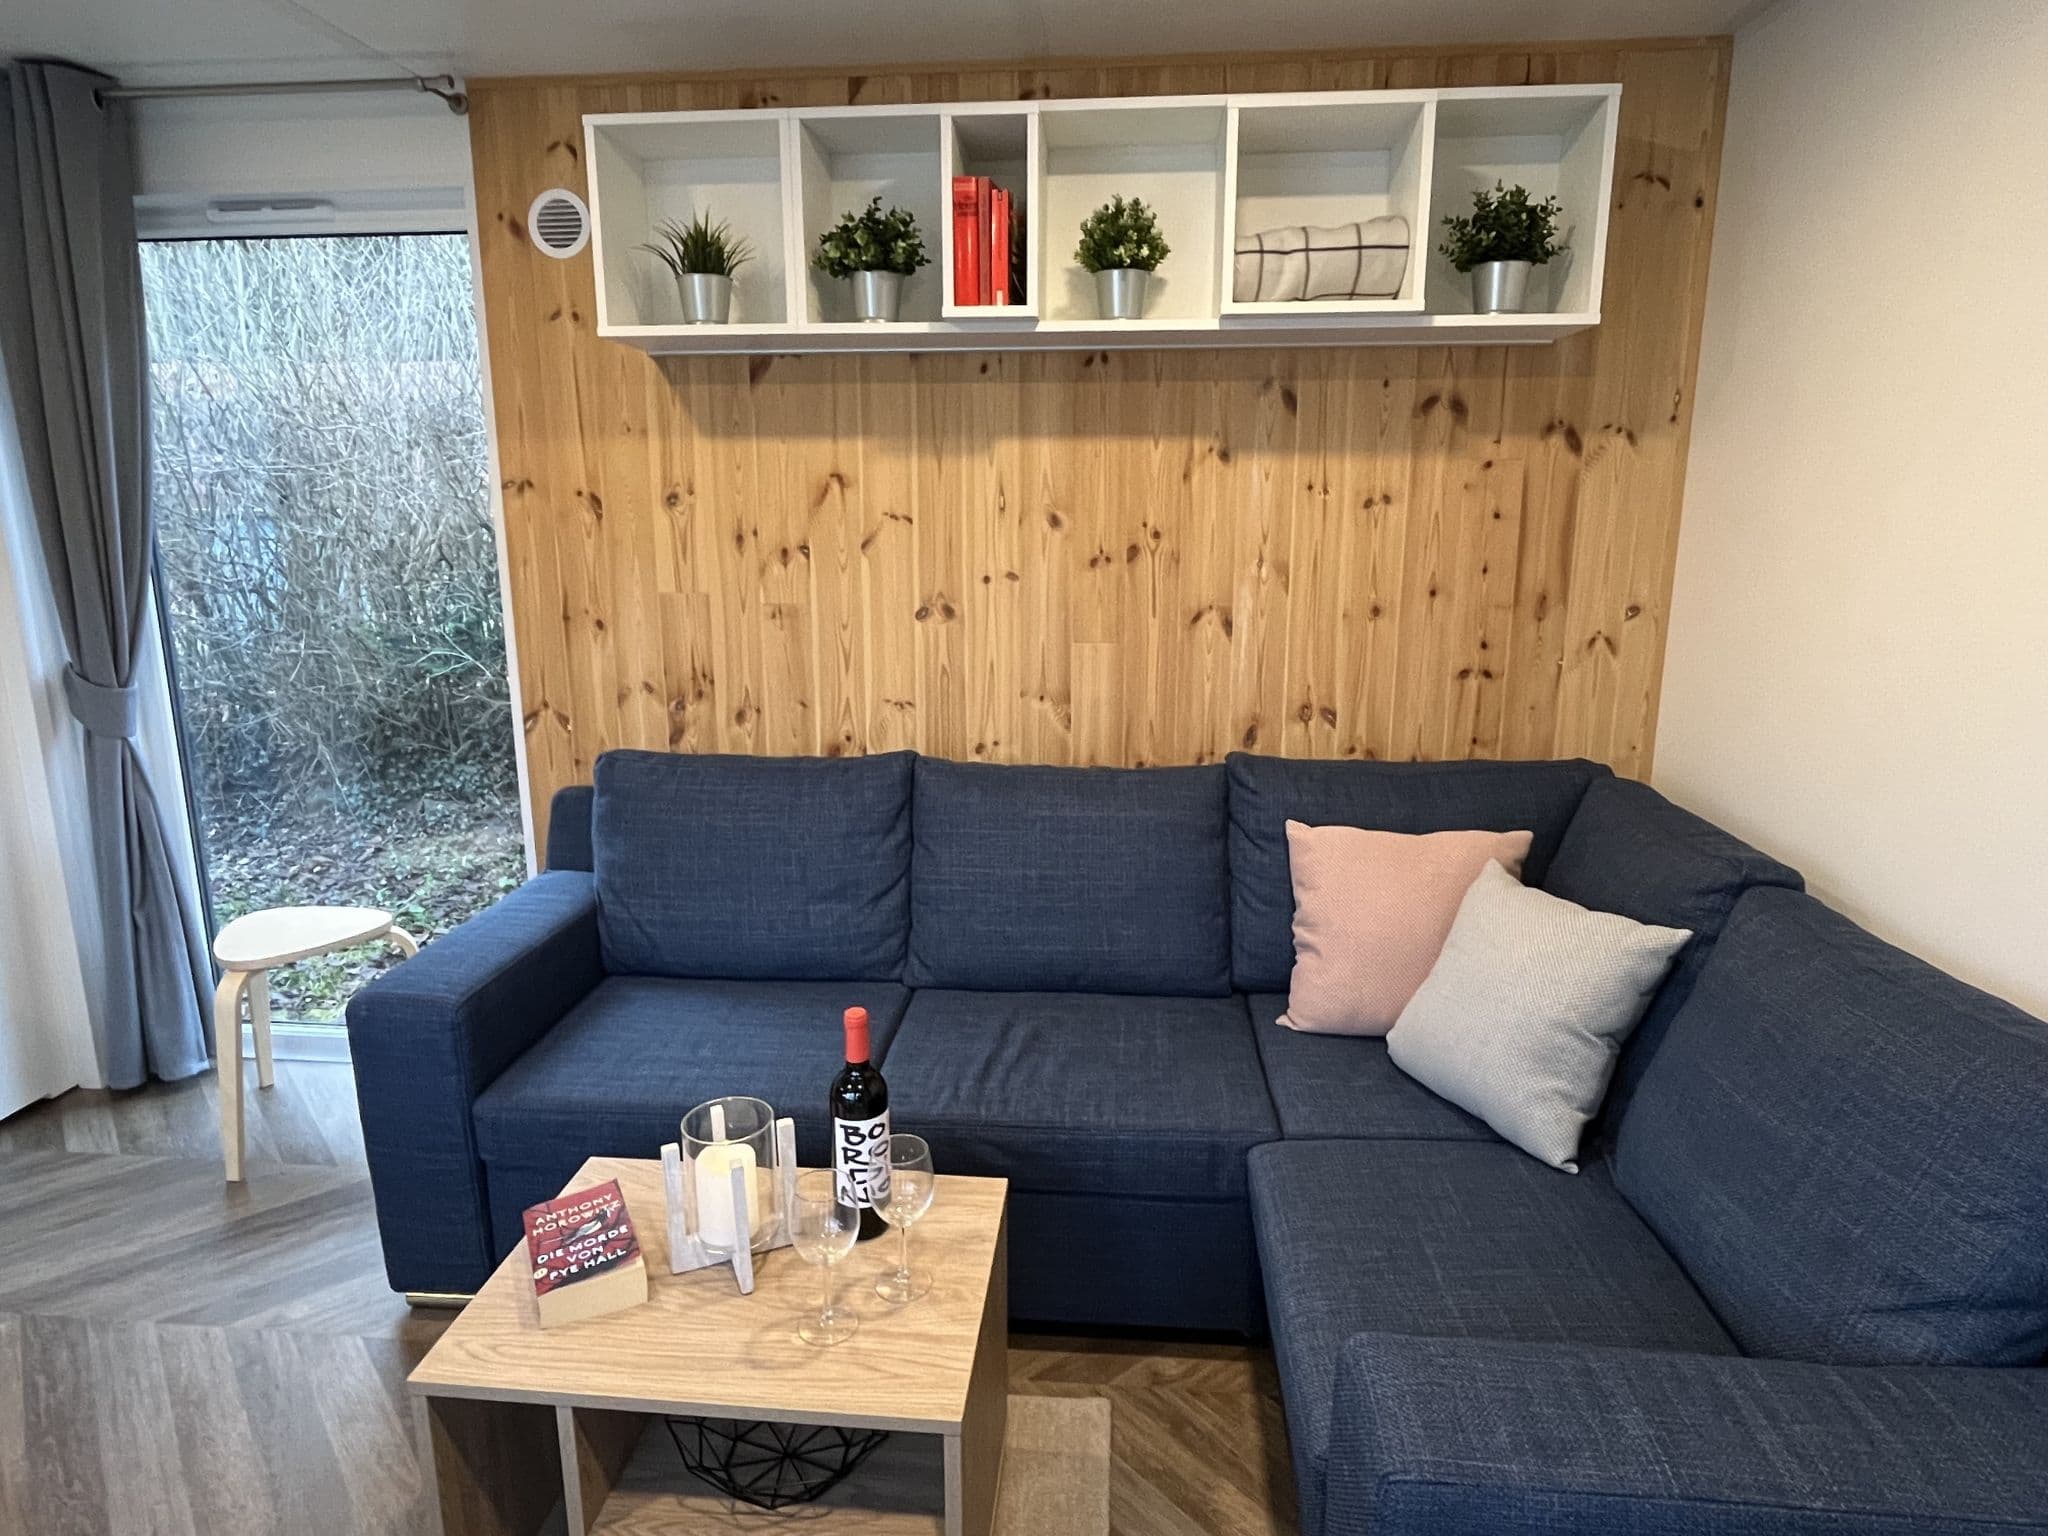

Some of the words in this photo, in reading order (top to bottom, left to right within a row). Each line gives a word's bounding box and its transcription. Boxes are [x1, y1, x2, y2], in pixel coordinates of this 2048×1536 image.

[532, 1199, 621, 1236] HOROWITZ
[536, 1193, 612, 1226] ANTHONY
[537, 1249, 563, 1264] DIE
[569, 1224, 628, 1251] MORDE
[567, 1246, 603, 1263] VON
[550, 1265, 578, 1280] PYE
[584, 1248, 626, 1269] HALL
